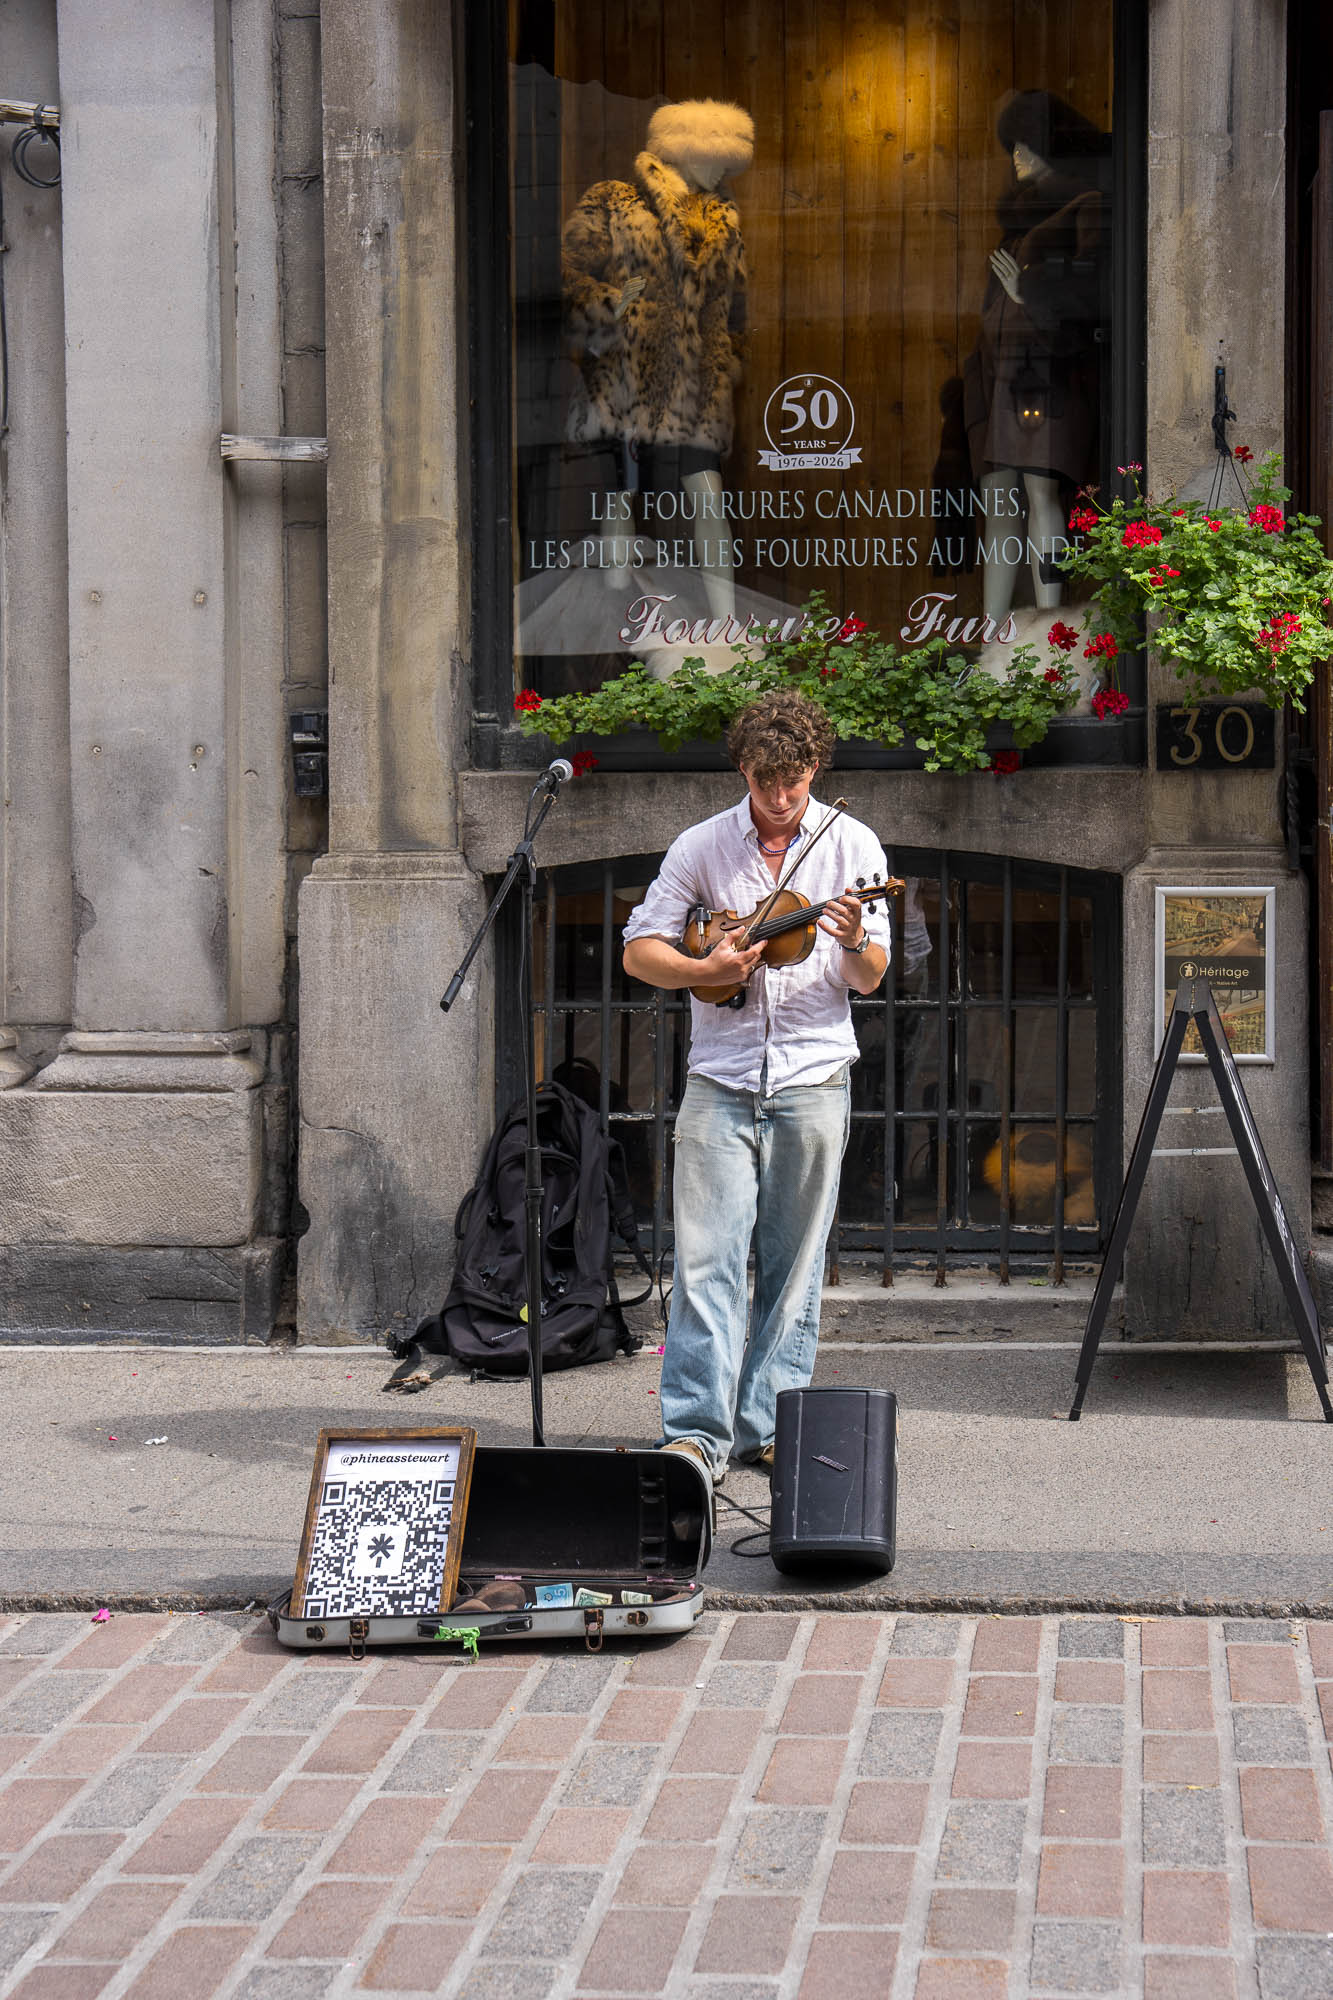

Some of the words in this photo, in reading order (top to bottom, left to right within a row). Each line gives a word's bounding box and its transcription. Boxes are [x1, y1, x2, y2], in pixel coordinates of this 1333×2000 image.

[780, 389, 838, 433] 50
[793, 439, 827, 449] YEARS
[590, 491, 632, 521] LES
[643, 489, 805, 520] FOURRURES
[815, 487, 1027, 520] CANADIENNES,
[529, 540, 571, 569] LES
[582, 538, 645, 569] PLUS
[655, 537, 744, 568] BELLES
[755, 536, 917, 567] FOURRURES
[928, 535, 965, 566] AU
[900, 592, 1019, 645] Furs
[1169, 706, 1255, 766] 30
[1199, 967, 1249, 979] Héritage
[340, 1453, 450, 1466] @phineasstewart
